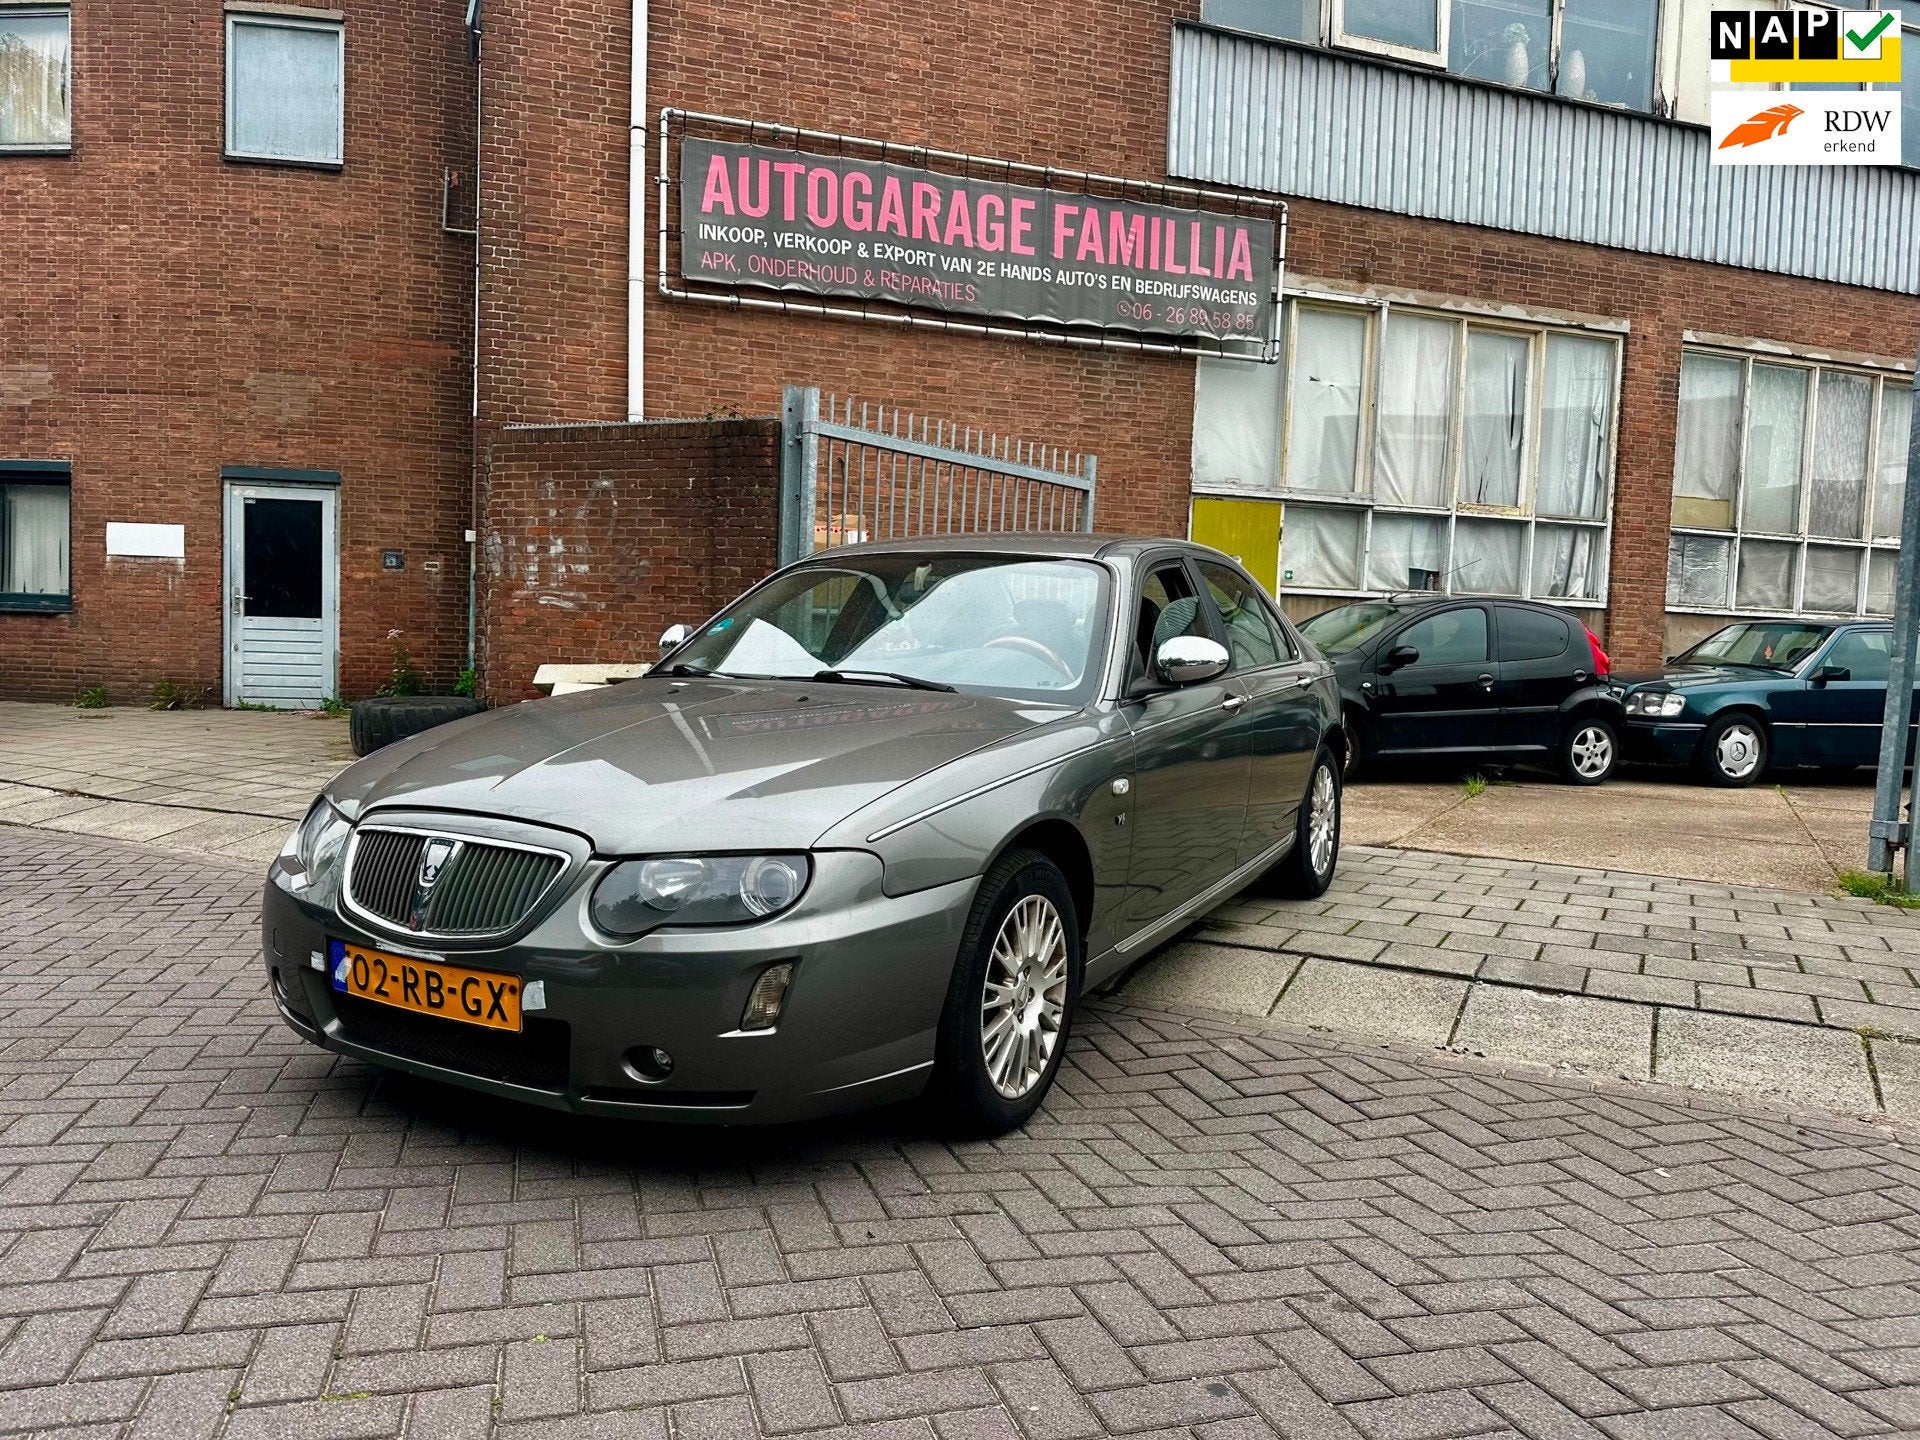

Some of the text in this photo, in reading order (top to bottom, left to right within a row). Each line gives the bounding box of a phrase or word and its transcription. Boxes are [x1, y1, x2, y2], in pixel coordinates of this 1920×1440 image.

[701, 154, 1254, 282] AUTOGARAGE FAMILLIA
[699, 223, 768, 248] INKOOP,
[773, 232, 852, 255] VERKOOP
[857, 242, 870, 258] &
[873, 243, 936, 268] EXPORT
[940, 255, 972, 273] VAN
[977, 260, 996, 277] 2E
[1000, 262, 1052, 283] HANDS
[1111, 276, 1131, 292] EN
[1135, 279, 1258, 306] BEDRIJFSWAGENS
[701, 251, 976, 302] APK, ONDERHOUD & REPARATIES
[1132, 302, 1152, 321] 06
[1166, 306, 1185, 325] 26
[1212, 310, 1232, 329] 58
[1236, 313, 1255, 331] 85
[352, 953, 509, 1023] 02-RB-GX
